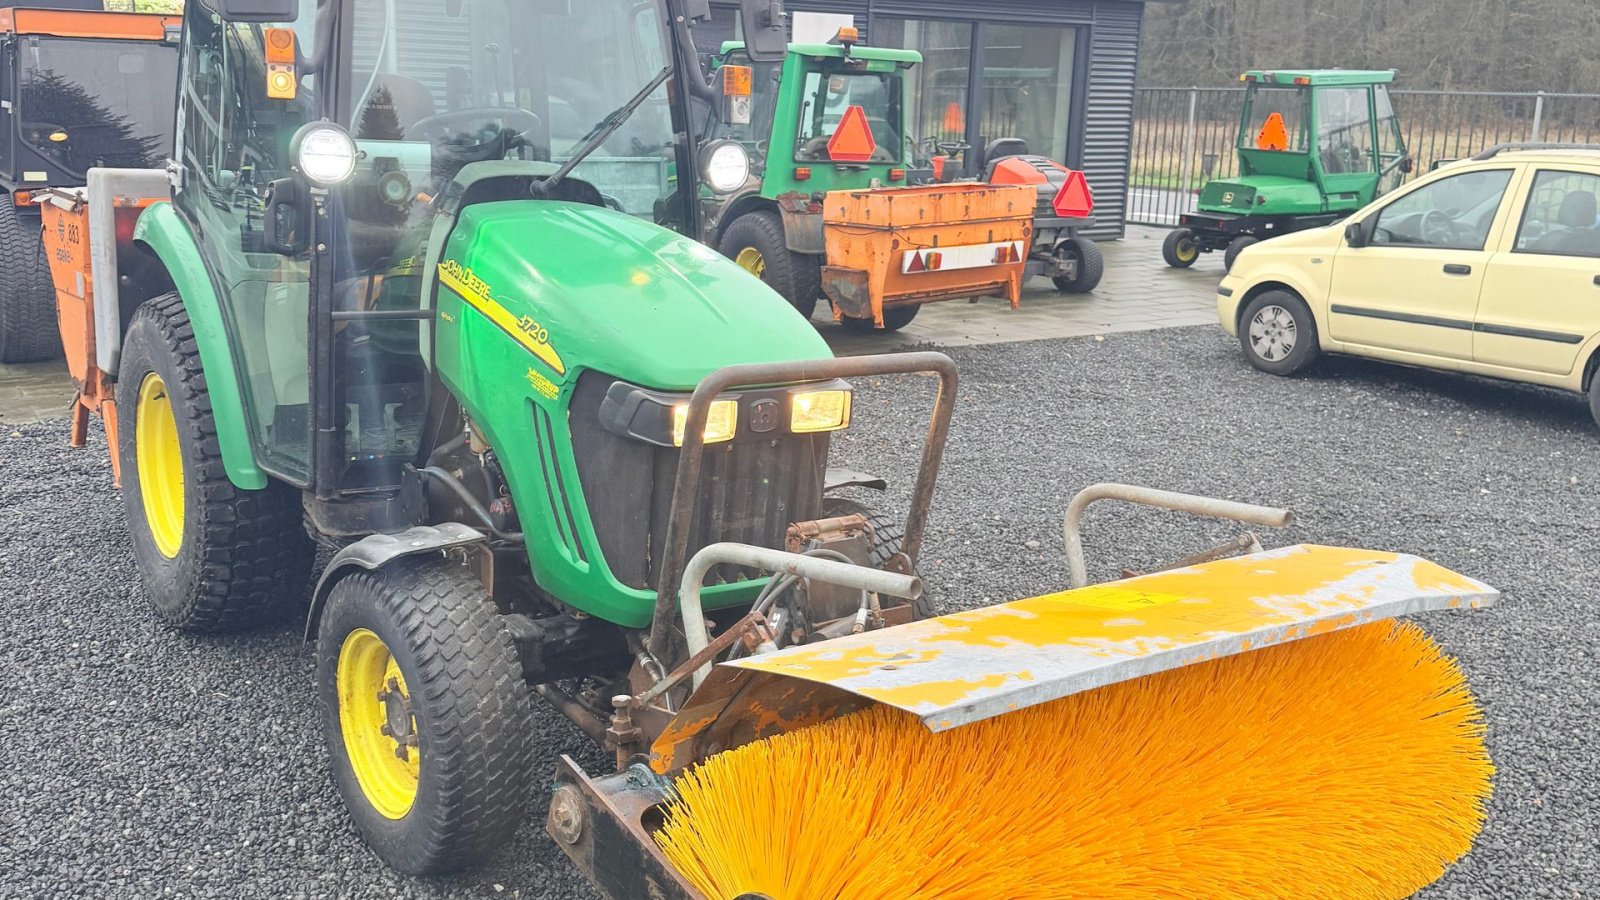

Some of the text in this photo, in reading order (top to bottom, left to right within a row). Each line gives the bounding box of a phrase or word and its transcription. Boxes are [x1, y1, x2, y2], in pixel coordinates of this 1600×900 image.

[440, 259, 463, 282] JOHN
[461, 266, 491, 302] DEERE
[516, 314, 549, 345] 3720
